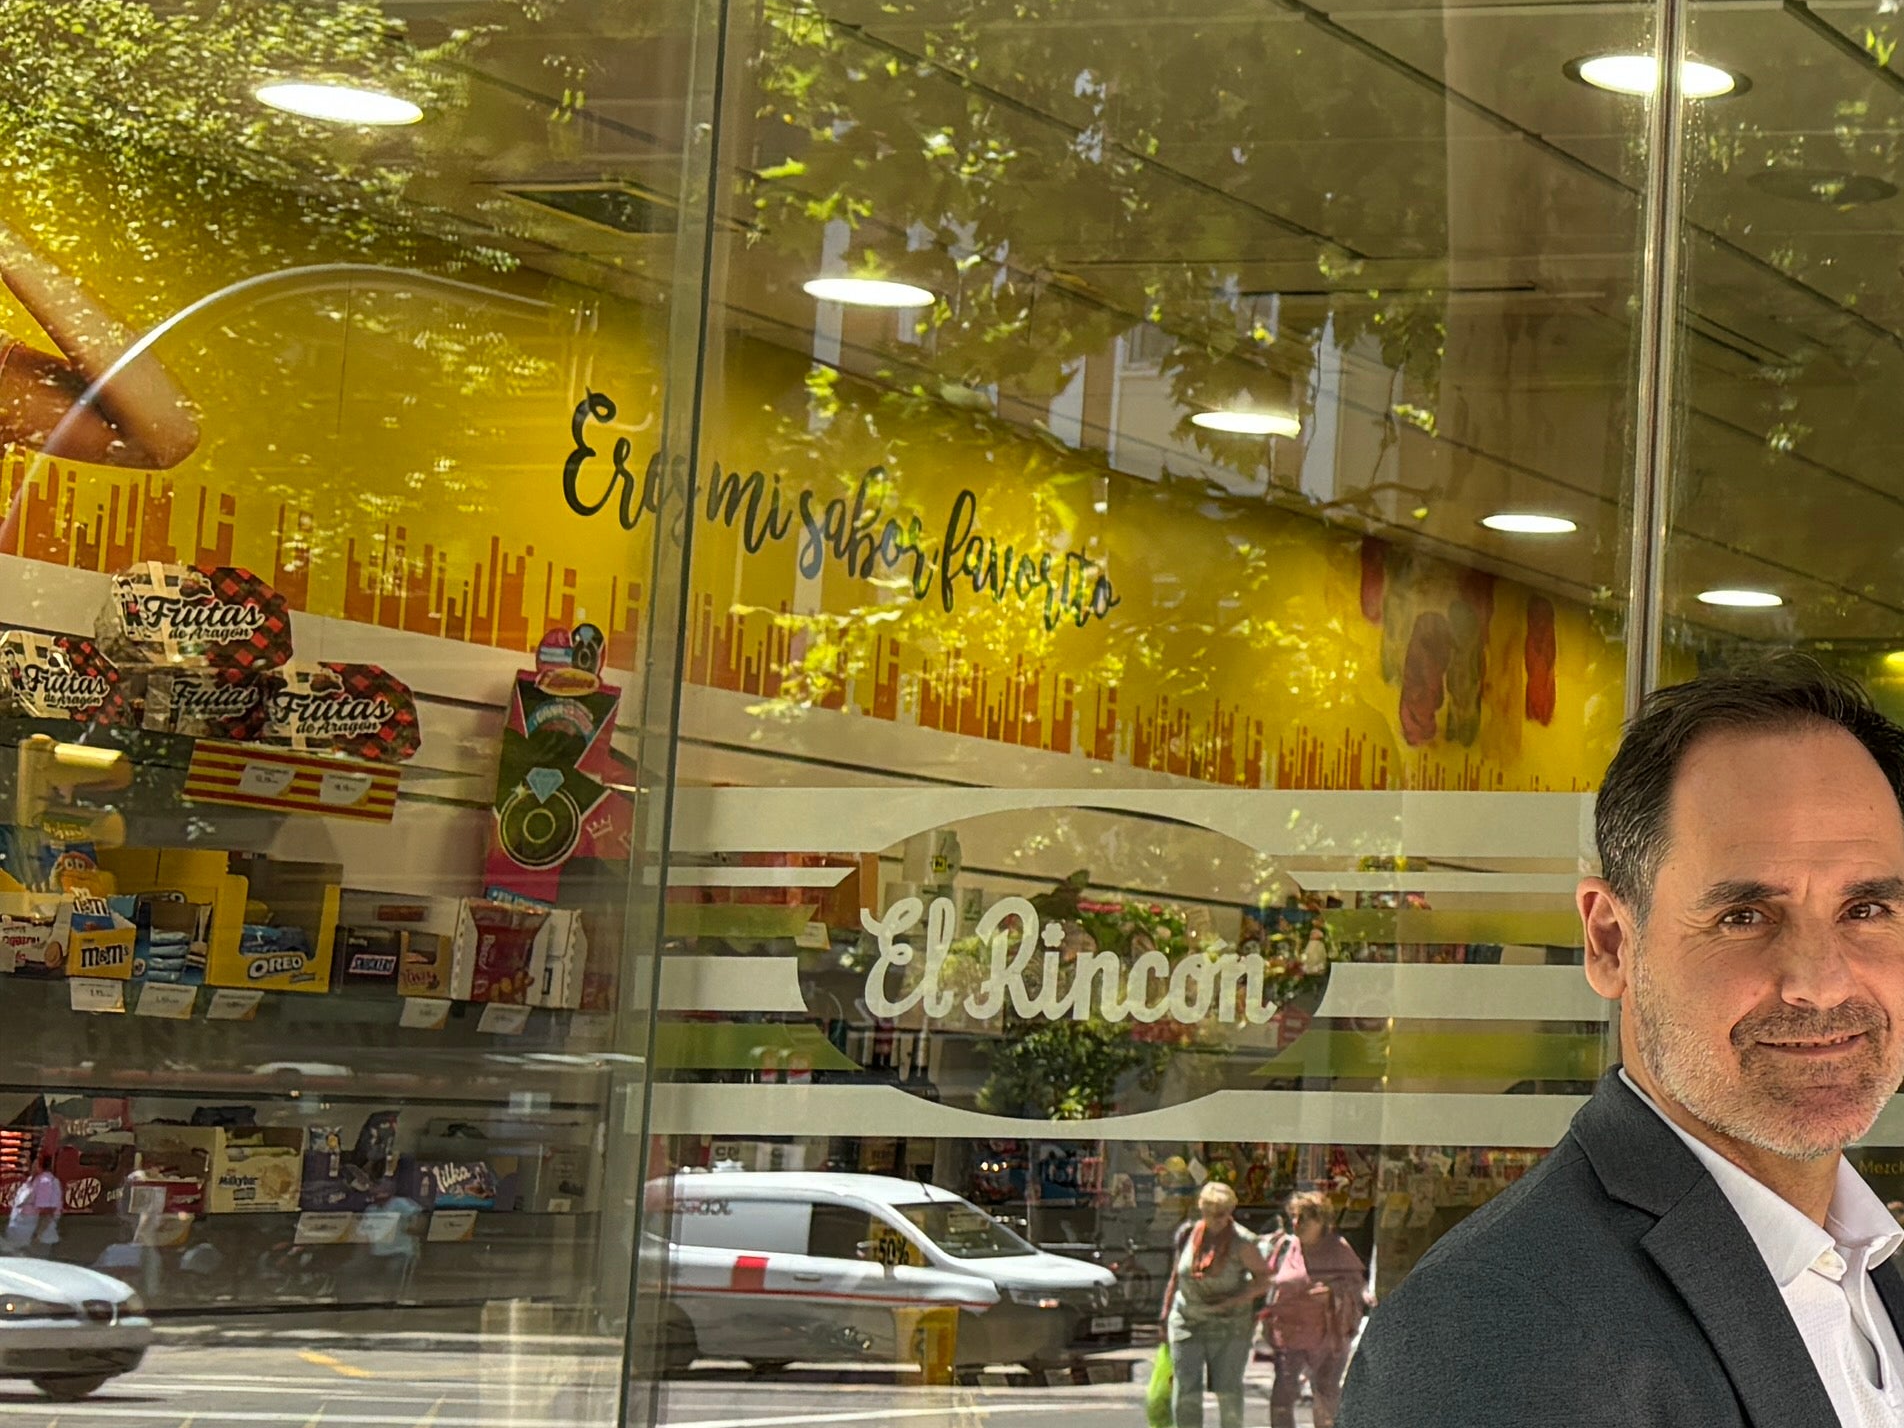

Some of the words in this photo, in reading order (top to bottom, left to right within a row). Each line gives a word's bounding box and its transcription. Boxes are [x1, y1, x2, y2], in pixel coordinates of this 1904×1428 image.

[704, 461, 793, 555] mi
[798, 465, 940, 602] sabor
[938, 489, 1121, 632] favorito
[143, 596, 265, 629] Frutas
[168, 627, 187, 640] de
[25, 666, 110, 696] Frutas
[171, 677, 260, 708] Frutas
[275, 690, 395, 725] Frutas
[247, 954, 304, 980] OREO
[860, 895, 956, 1020] El
[964, 896, 1279, 1026] Rincón
[68, 1179, 101, 1208] KitKat
